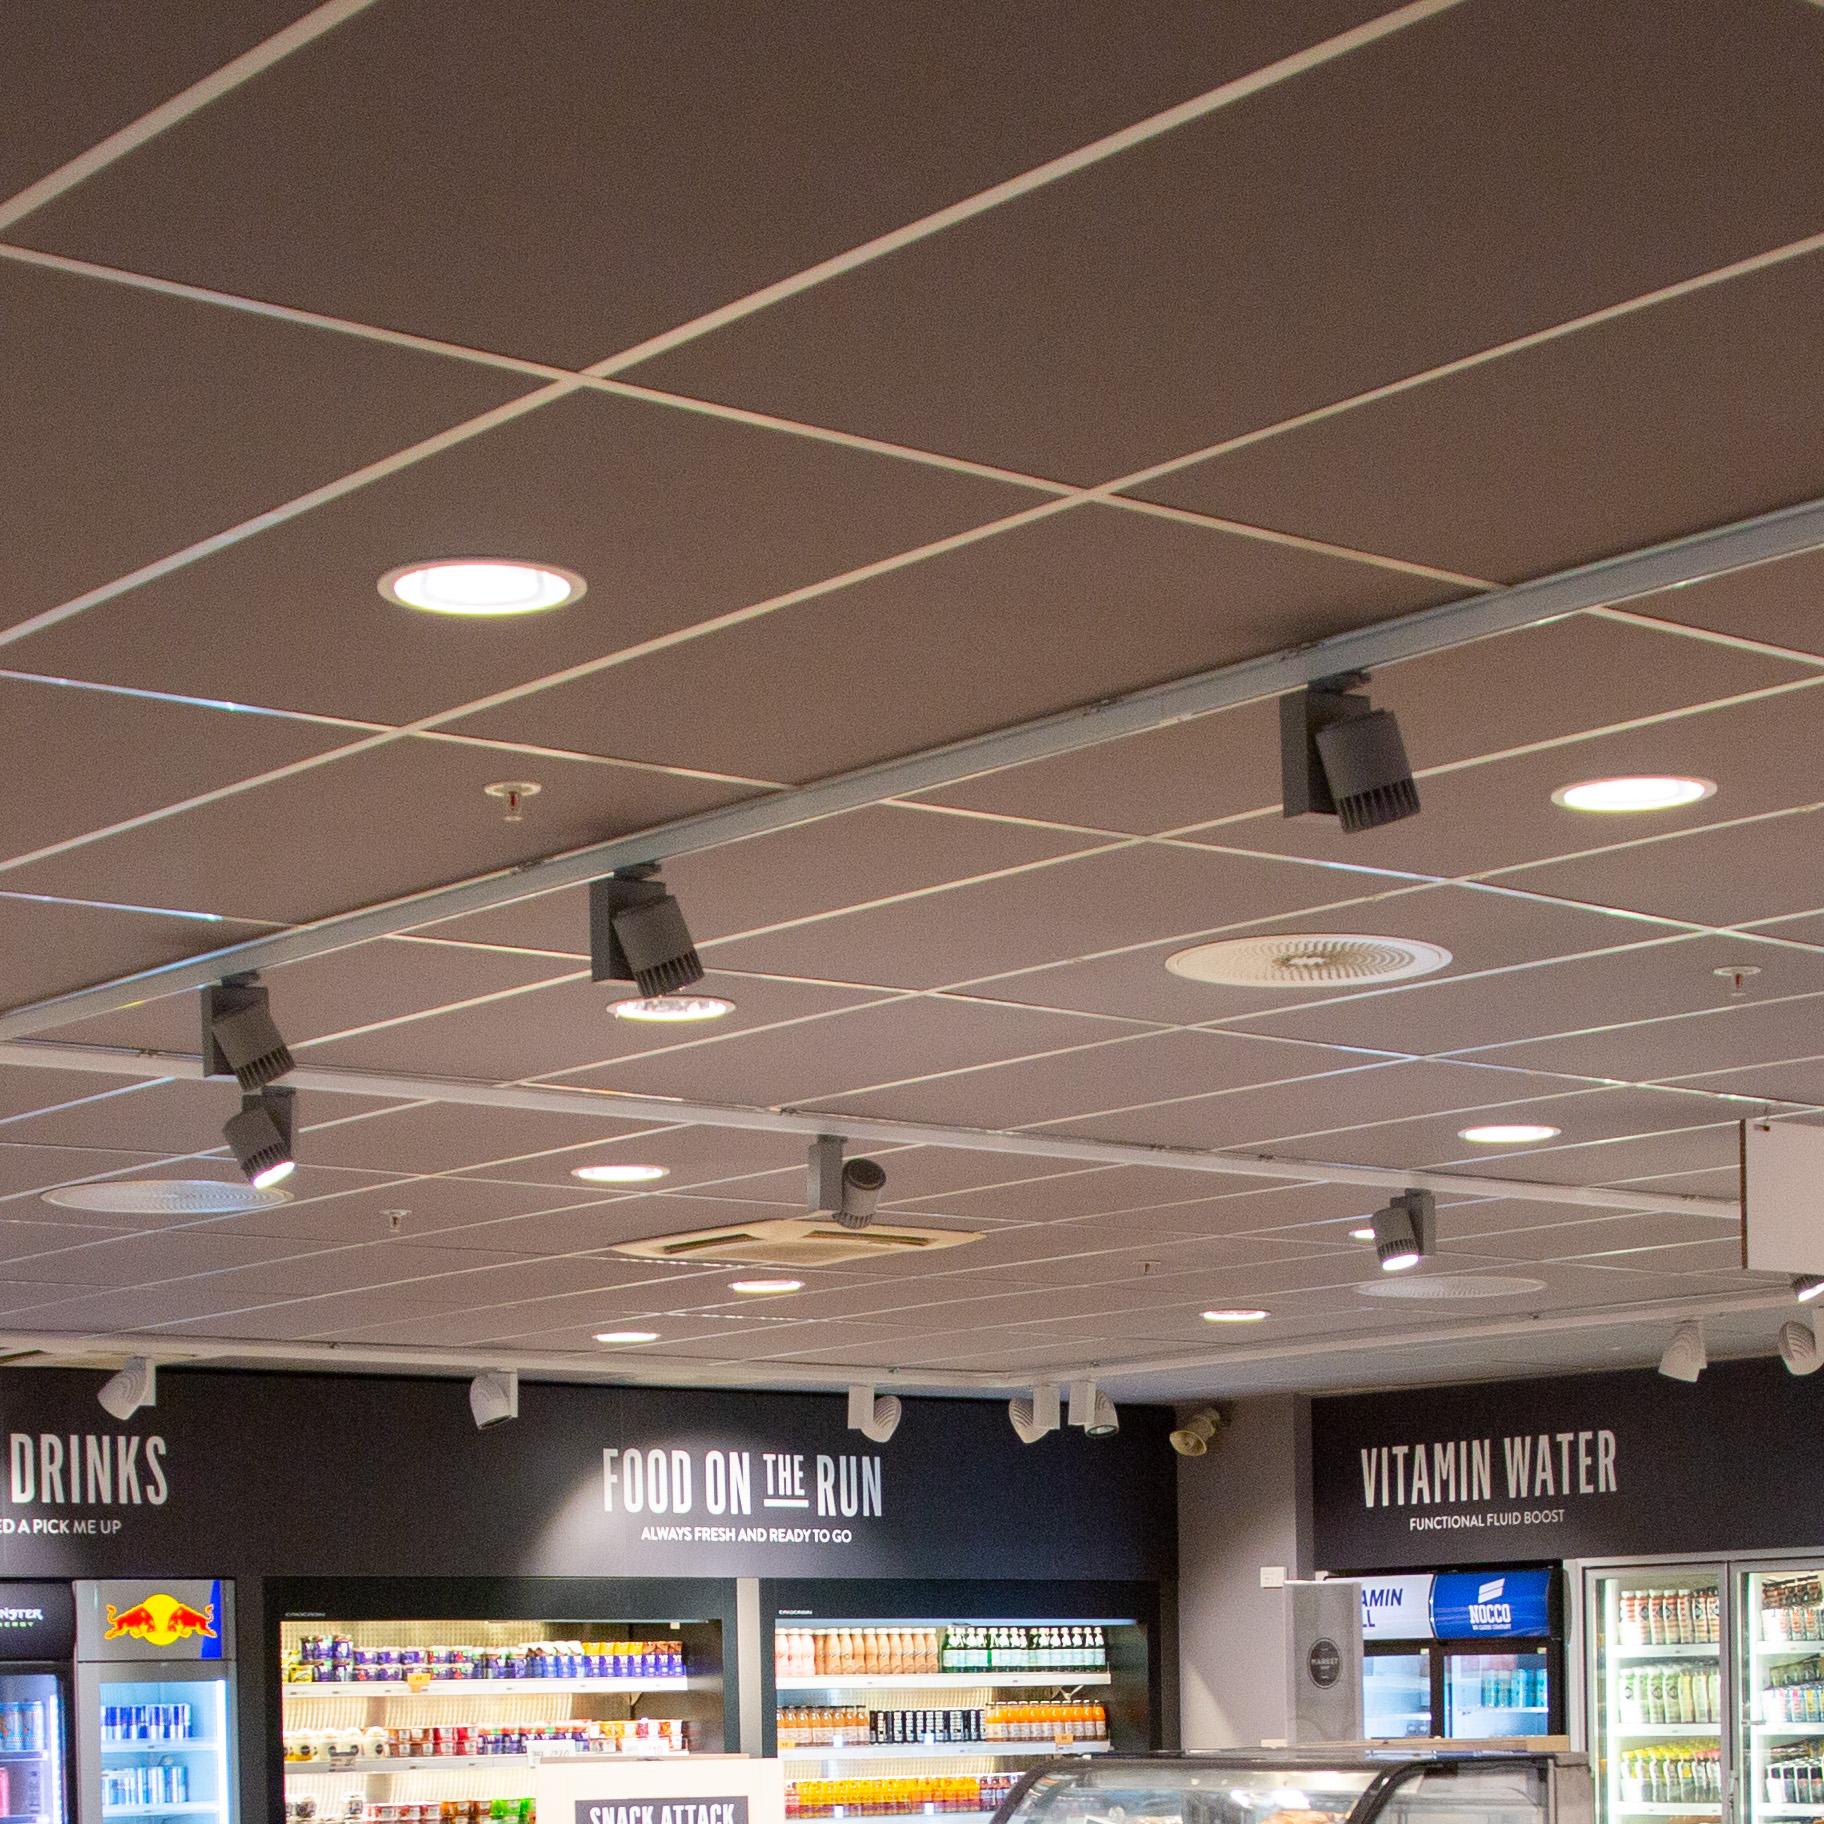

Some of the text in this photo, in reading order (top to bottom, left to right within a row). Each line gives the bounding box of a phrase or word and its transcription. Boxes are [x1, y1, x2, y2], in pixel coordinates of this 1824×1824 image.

[10, 1433, 168, 1505] DRINKS
[1360, 1429, 1618, 1508] VITAMIN WATER
[603, 1448, 882, 1517] FOOD ON THE RUN
[17, 1519, 31, 1534] A
[34, 1519, 69, 1534] PICK
[73, 1520, 96, 1535] ME
[100, 1520, 122, 1535] UP
[1409, 1509, 1565, 1531] FUNCTIONAL FLUID BOOST
[641, 1526, 853, 1543] ALWAYS FRESH AND READY TO GO
[1468, 1604, 1511, 1624] NOCCO
